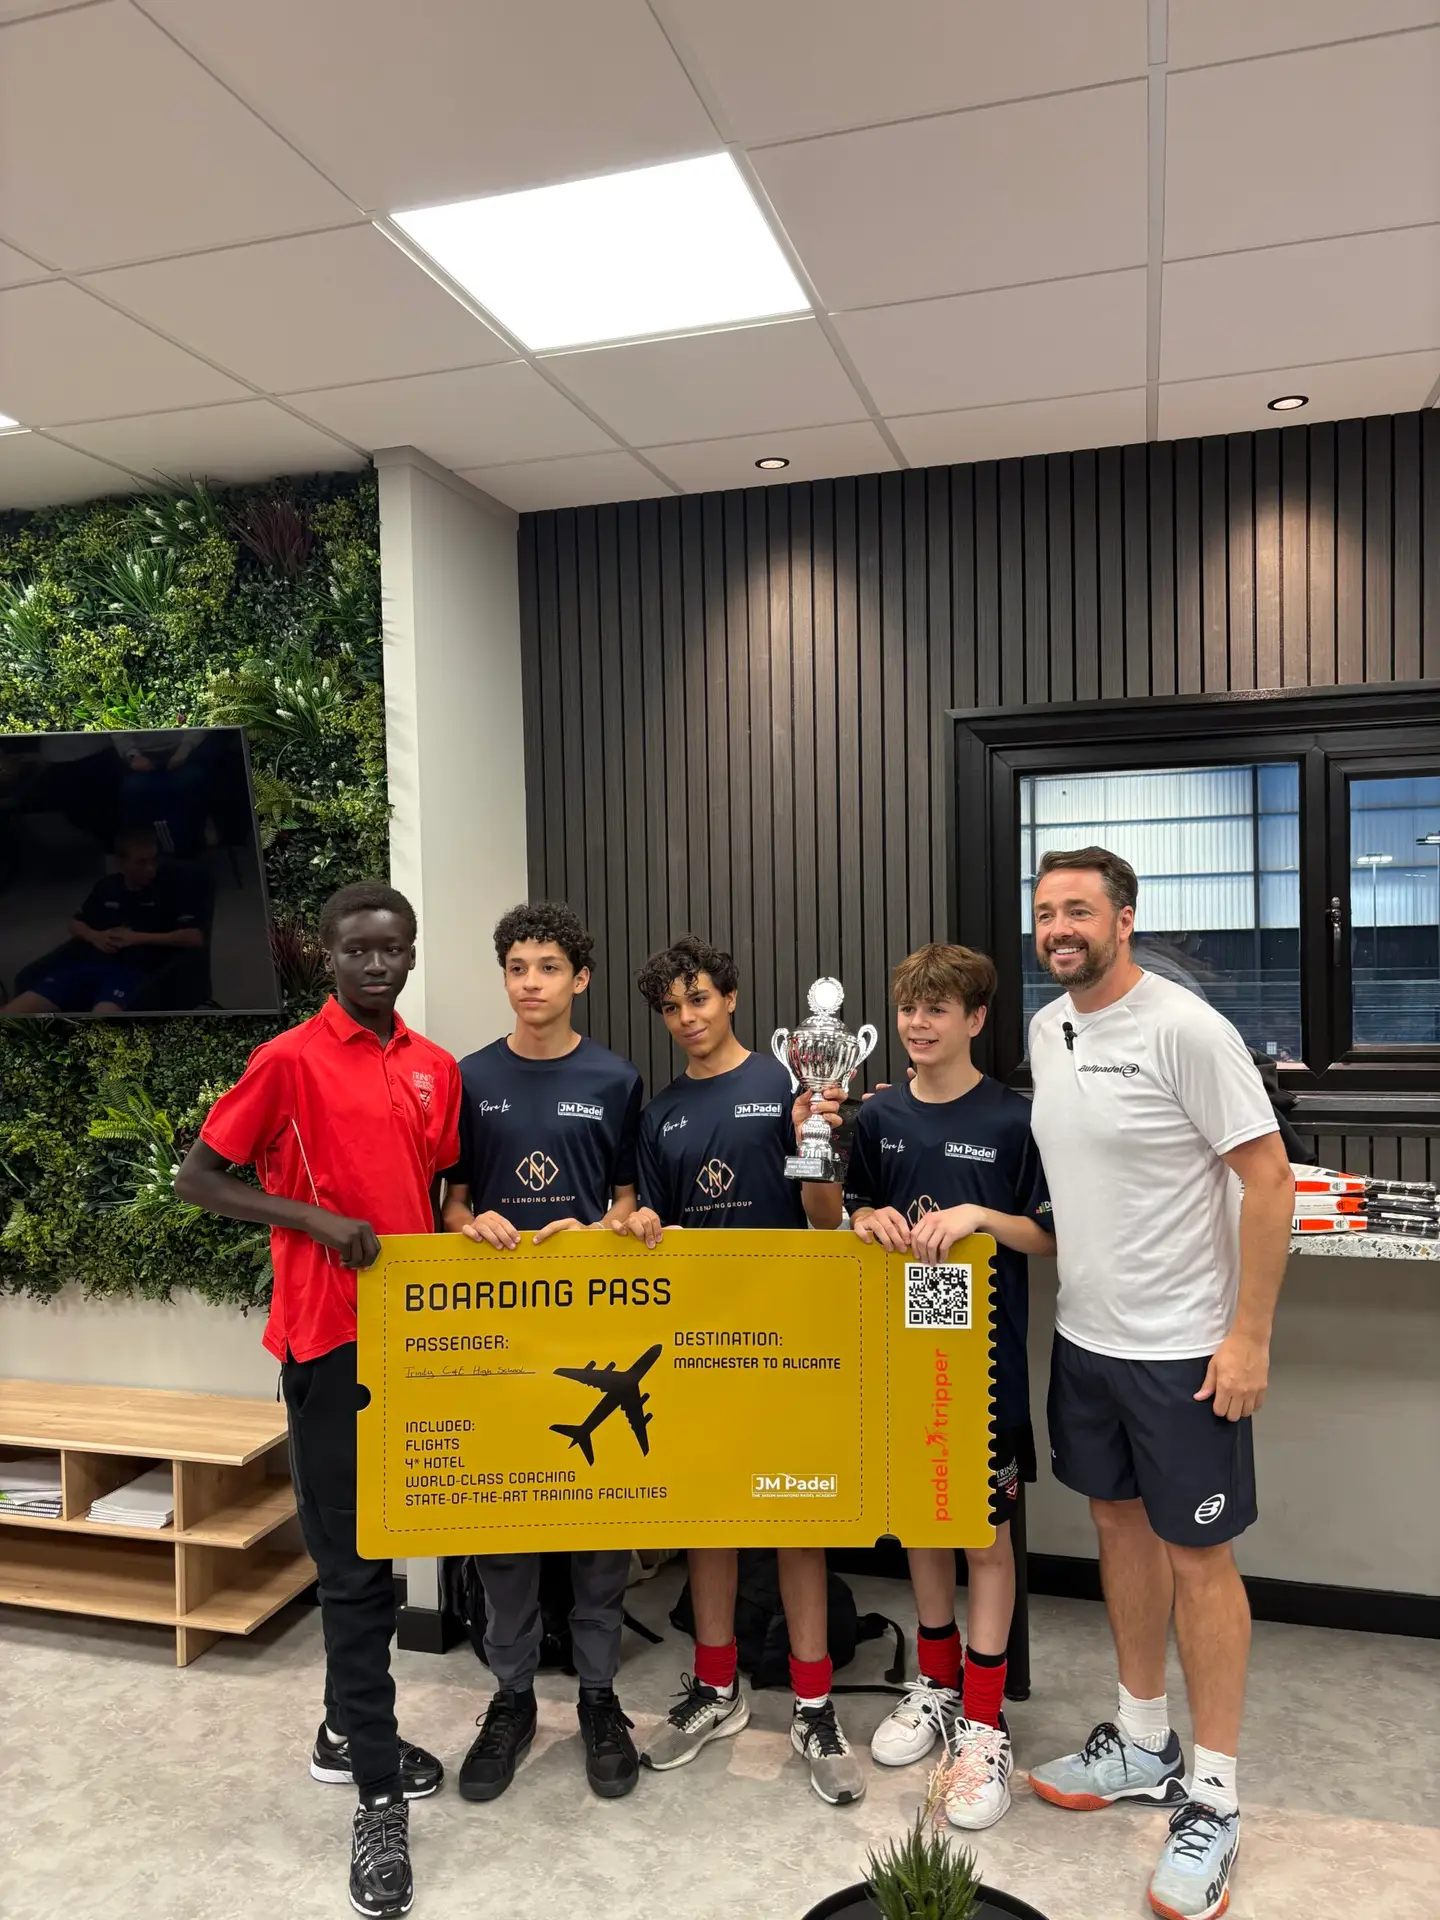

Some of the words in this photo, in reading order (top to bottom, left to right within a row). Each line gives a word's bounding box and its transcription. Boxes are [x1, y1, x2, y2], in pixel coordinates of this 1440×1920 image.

[1078, 1064, 1124, 1074] Bullpadel
[560, 1103, 575, 1113] JM
[576, 1102, 602, 1116] Padel
[736, 1105, 751, 1113] JM
[752, 1102, 780, 1113] Padel
[947, 1144, 963, 1153] JM
[964, 1143, 995, 1159] Padel
[512, 1196, 547, 1204] LENDING
[550, 1195, 576, 1203] GROUP
[727, 1200, 753, 1208] GROUP
[405, 1279, 573, 1311] BOARDING
[588, 1278, 671, 1306] PASS
[405, 1335, 509, 1352] PASSENGER:
[674, 1331, 783, 1346] DESTINATION:
[674, 1357, 759, 1369] MANCHESTER
[763, 1357, 777, 1369] TO
[782, 1357, 841, 1370] ALICANTE
[932, 1349, 953, 1428] tripper
[405, 1420, 475, 1433] INCLUDED:
[405, 1438, 460, 1451] FLIGHTS
[424, 1456, 466, 1469] HOTEL
[405, 1473, 504, 1488] WORLD-CLASS
[508, 1470, 576, 1485] COACHING
[755, 1477, 781, 1490] JM
[785, 1475, 835, 1491] Padel
[405, 1490, 528, 1506] STATE-OF-THE-ART
[532, 1488, 593, 1502] TRAINING
[598, 1487, 668, 1500] FACILITIES
[931, 1459, 953, 1521] padel
